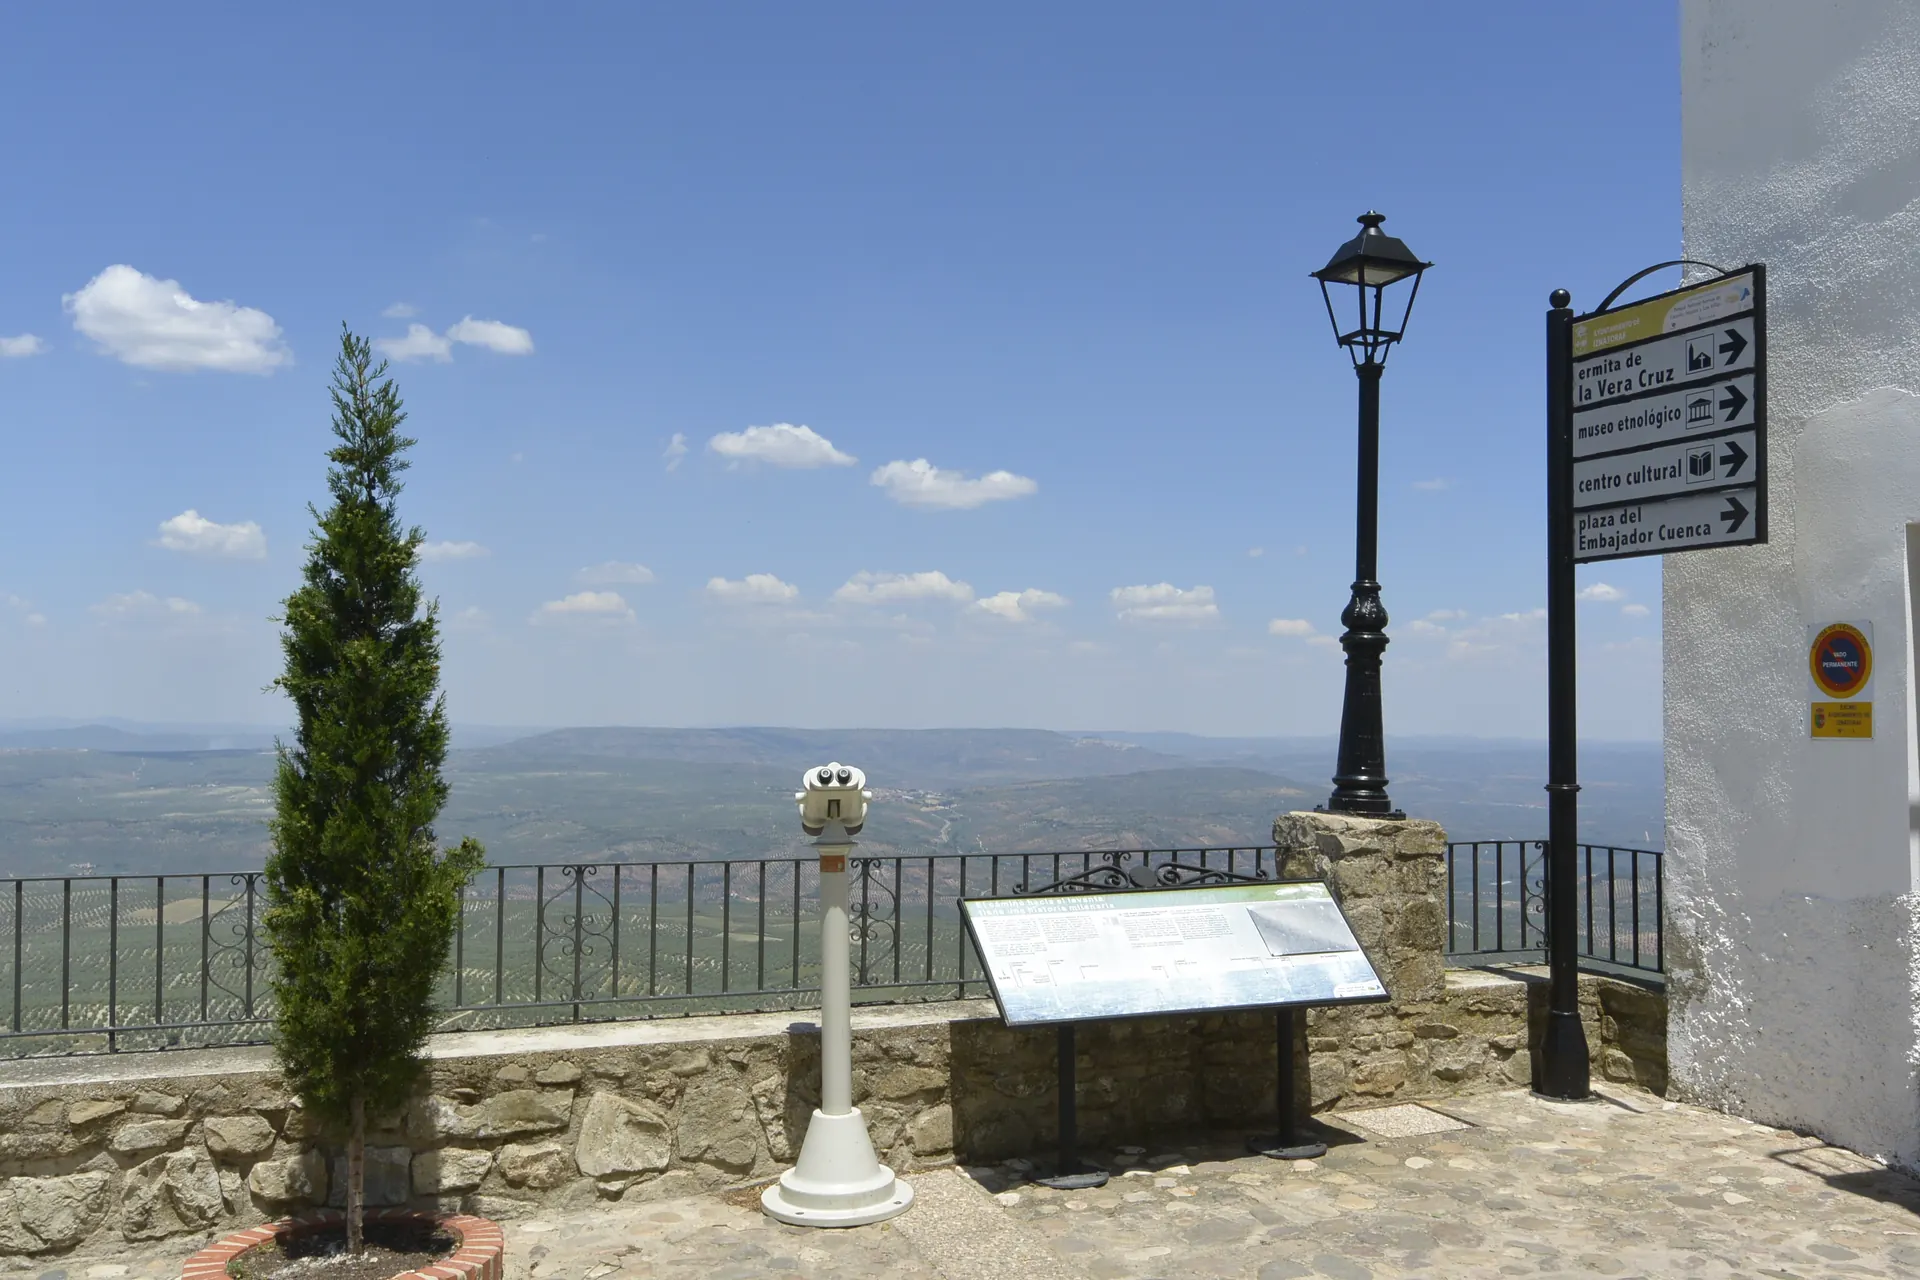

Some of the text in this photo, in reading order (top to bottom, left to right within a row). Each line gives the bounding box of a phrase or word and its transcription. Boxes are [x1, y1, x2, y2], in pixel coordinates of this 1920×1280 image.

[1579, 352, 1642, 379] ermita de
[1578, 368, 1674, 402] la Vera Cruz
[1578, 406, 1681, 440] museo etnológico
[1578, 459, 1682, 493] centro cultural
[1579, 507, 1642, 533] plaza del
[1579, 523, 1711, 551] Embajador Cuenca
